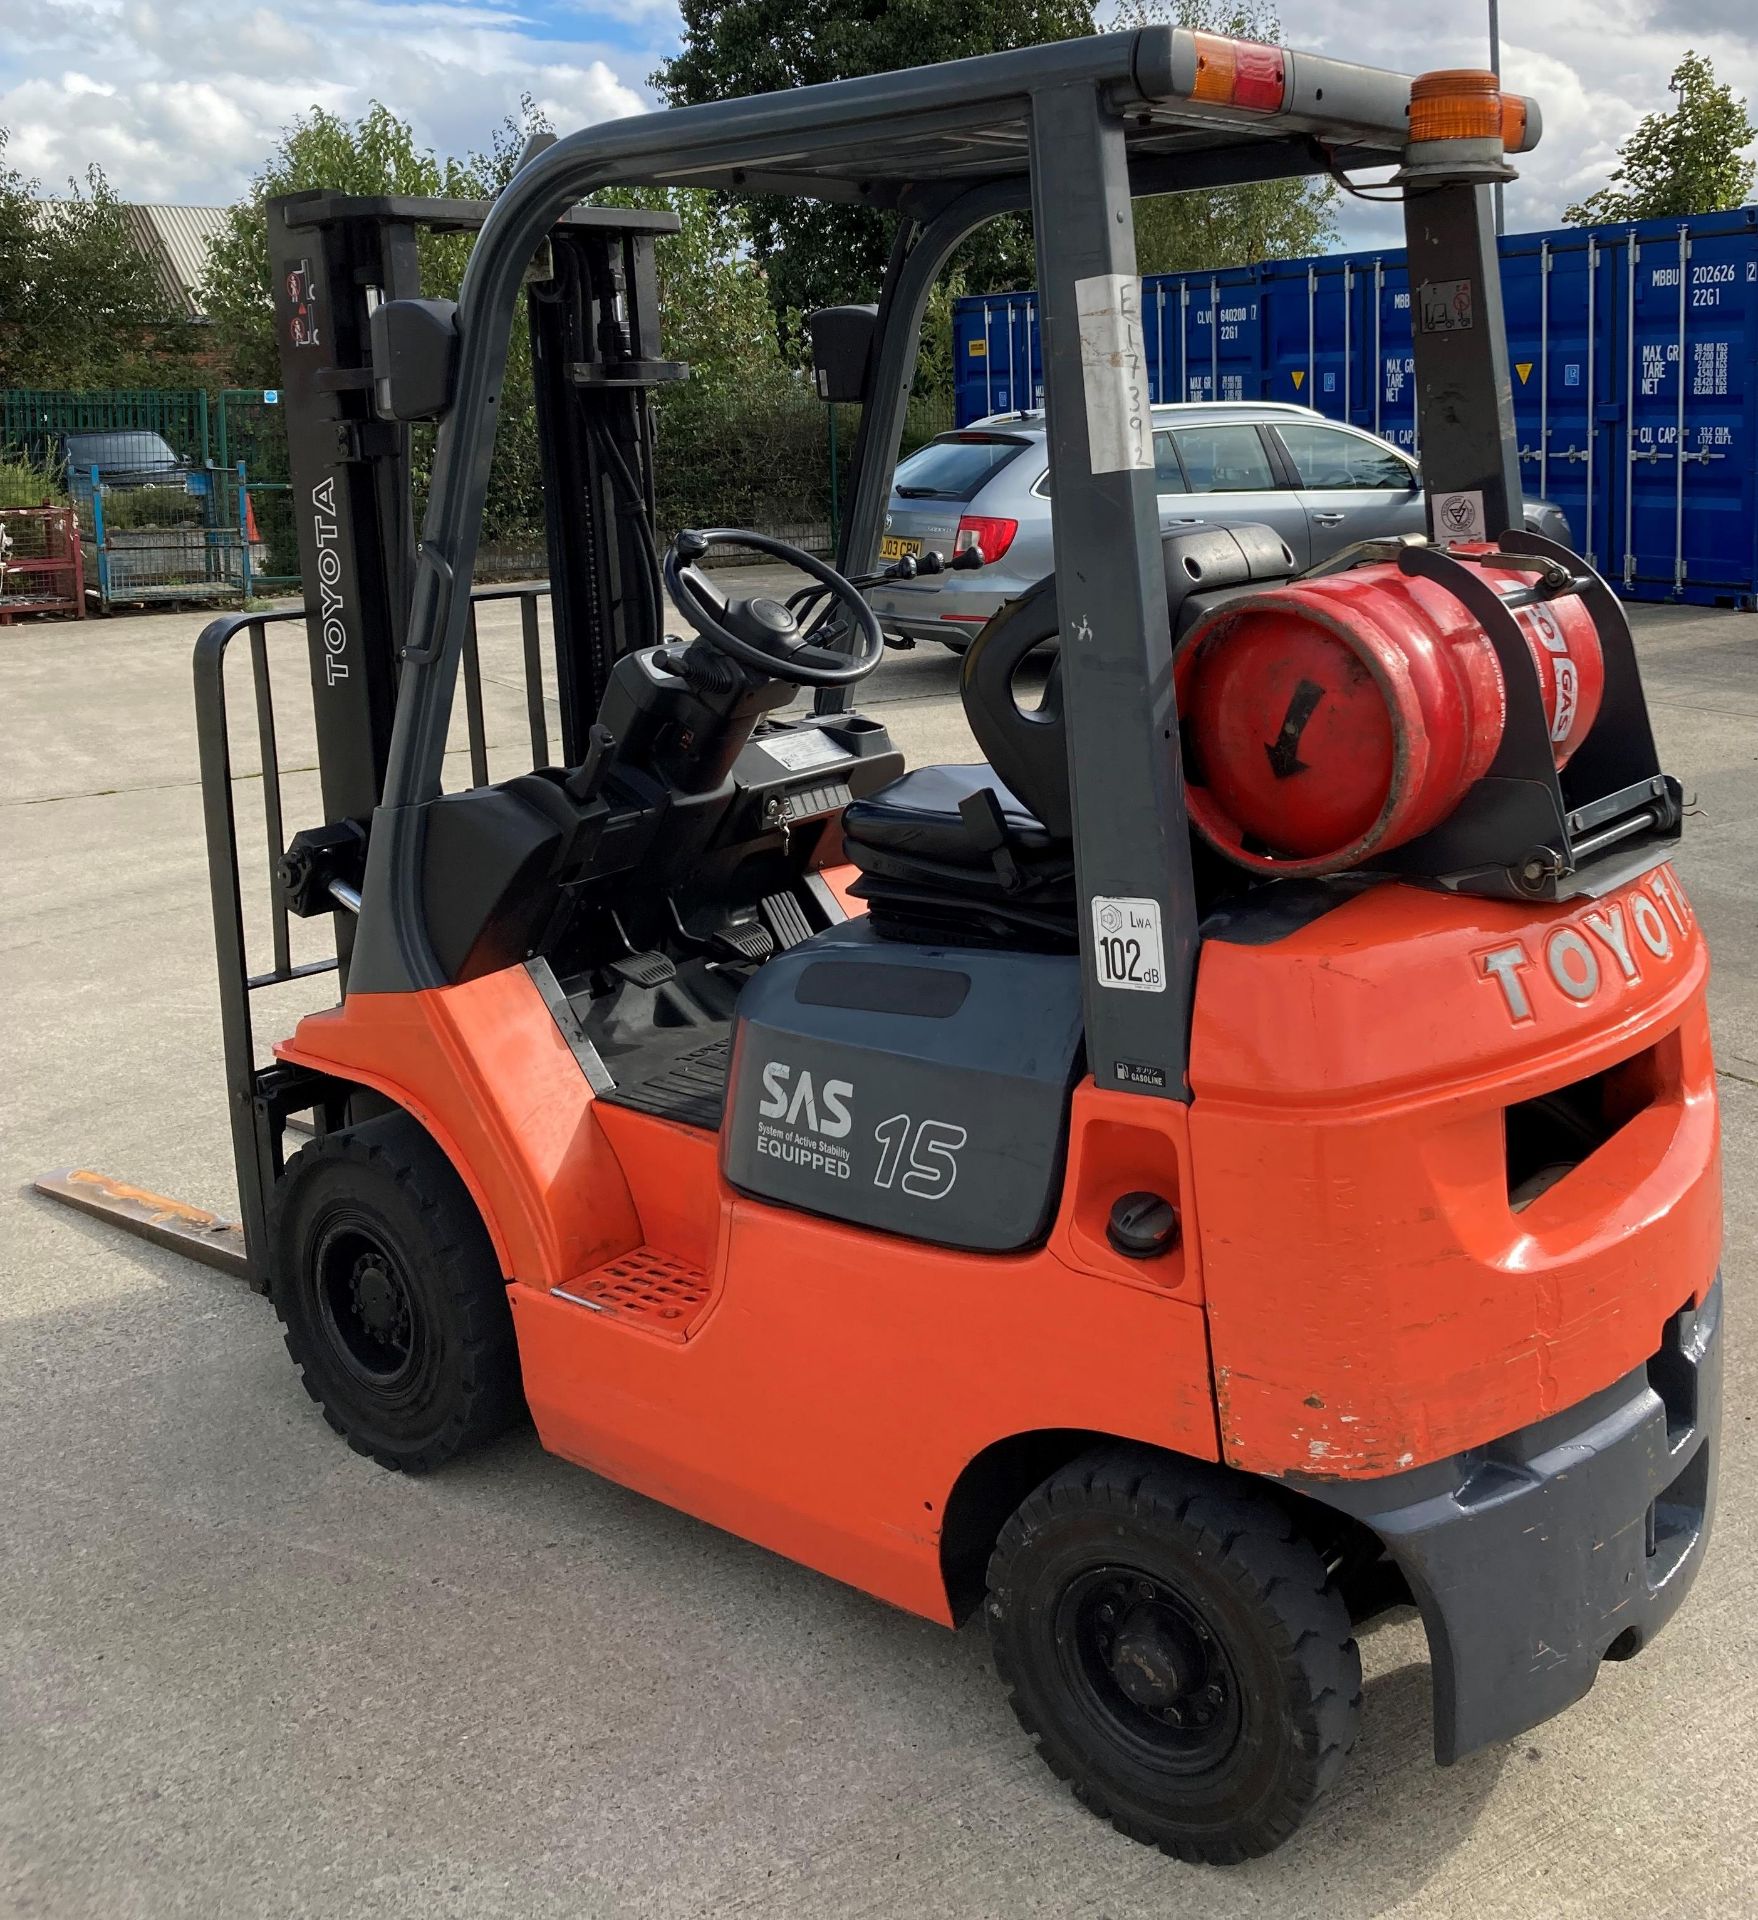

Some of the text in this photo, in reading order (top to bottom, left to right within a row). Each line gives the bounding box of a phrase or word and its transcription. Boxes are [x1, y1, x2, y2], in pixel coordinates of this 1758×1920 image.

[1652, 262, 1756, 287] MBBU 202626 2
[1692, 288, 1720, 306] 22G1
[1220, 308, 1247, 323] 640200
[1220, 326, 1238, 340] 22G1
[1643, 361, 1666, 378] TARE
[1386, 373, 1404, 388] TARE
[1641, 379, 1659, 395] NET
[1385, 387, 1399, 402] NET
[312, 476, 349, 686] TOYOTA
[1557, 669, 1573, 732] GAS
[1099, 937, 1160, 984] 102 dB
[1131, 1072, 1163, 1086] GASOLINE
[759, 1061, 853, 1138] SAS
[757, 1121, 851, 1162] System of Active Stability
[756, 1135, 851, 1180] EQUIPPED
[873, 1113, 968, 1200] 15
